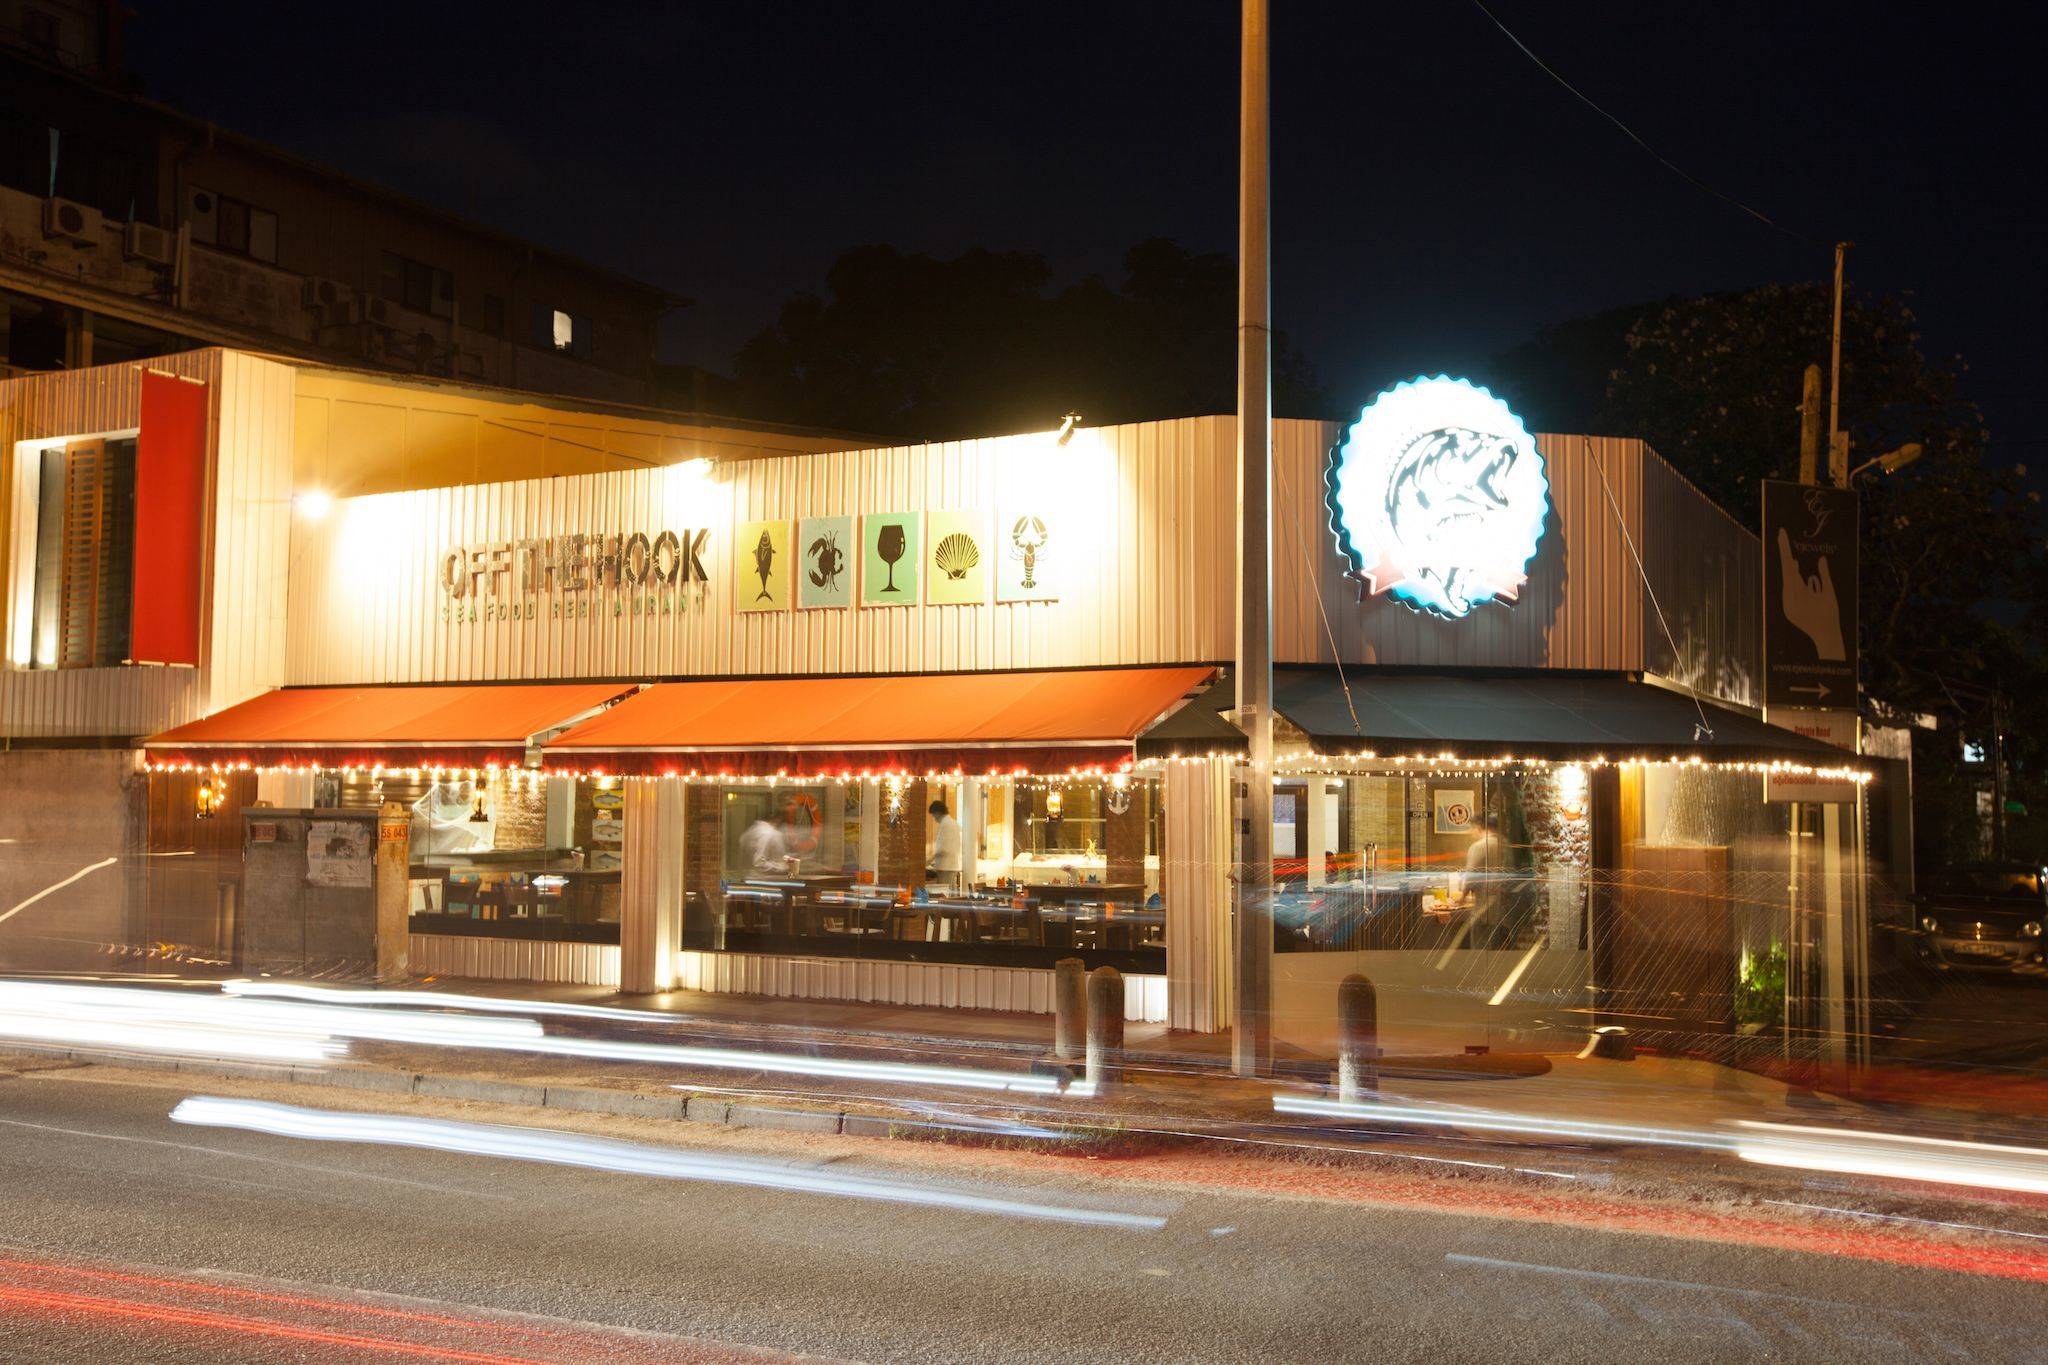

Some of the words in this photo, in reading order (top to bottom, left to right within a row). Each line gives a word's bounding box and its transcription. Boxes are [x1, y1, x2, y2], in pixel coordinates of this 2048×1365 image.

[440, 542, 511, 599] OFF
[516, 533, 587, 594] THE
[593, 528, 711, 588] HOOK
[1816, 726, 1831, 737] Road
[393, 828, 406, 838] 043
